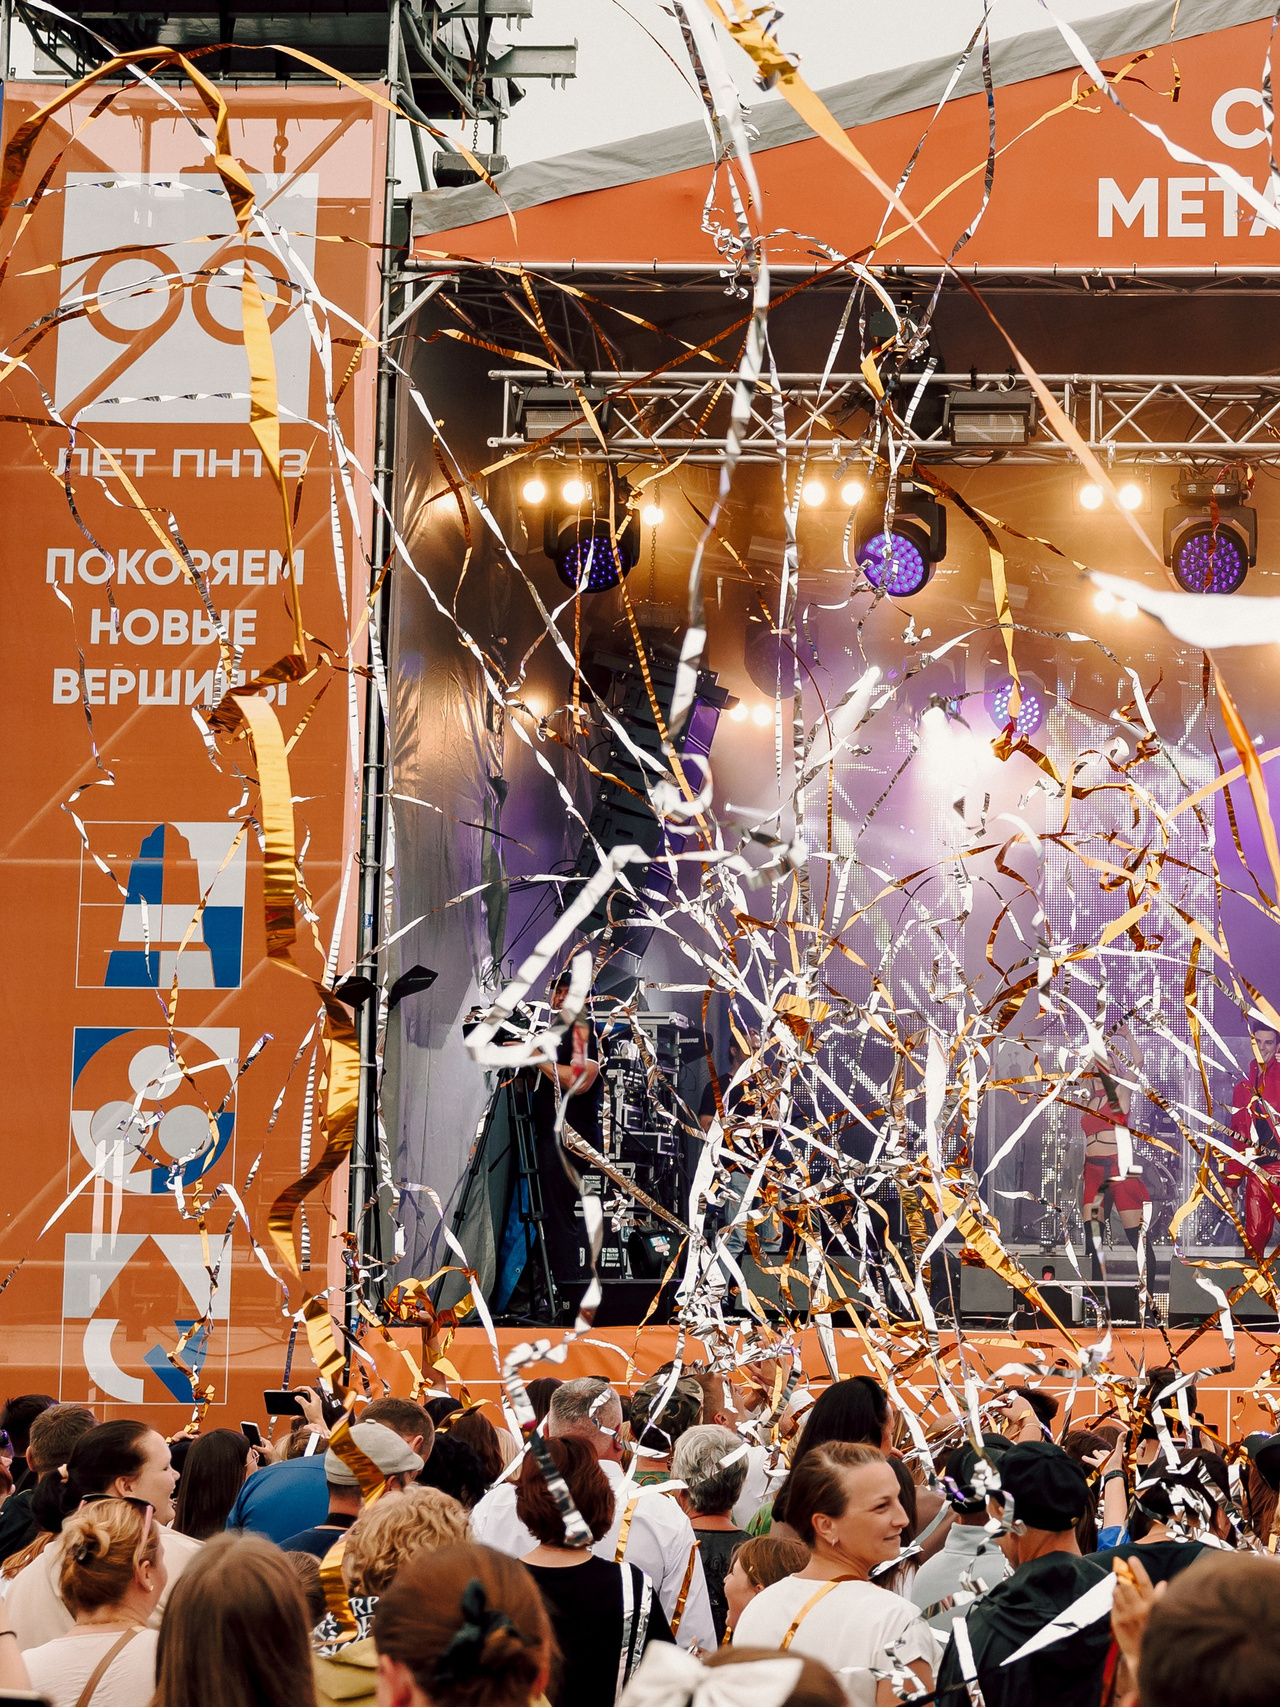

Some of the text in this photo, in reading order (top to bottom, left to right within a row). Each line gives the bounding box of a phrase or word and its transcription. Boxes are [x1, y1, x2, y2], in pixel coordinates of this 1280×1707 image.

[1211, 87, 1268, 149] С
[54, 447, 308, 478] ЛЕТ ПНТЗ
[46, 548, 305, 586] ПОКОРЯЕМ
[90, 608, 257, 646] НОВЫЕ
